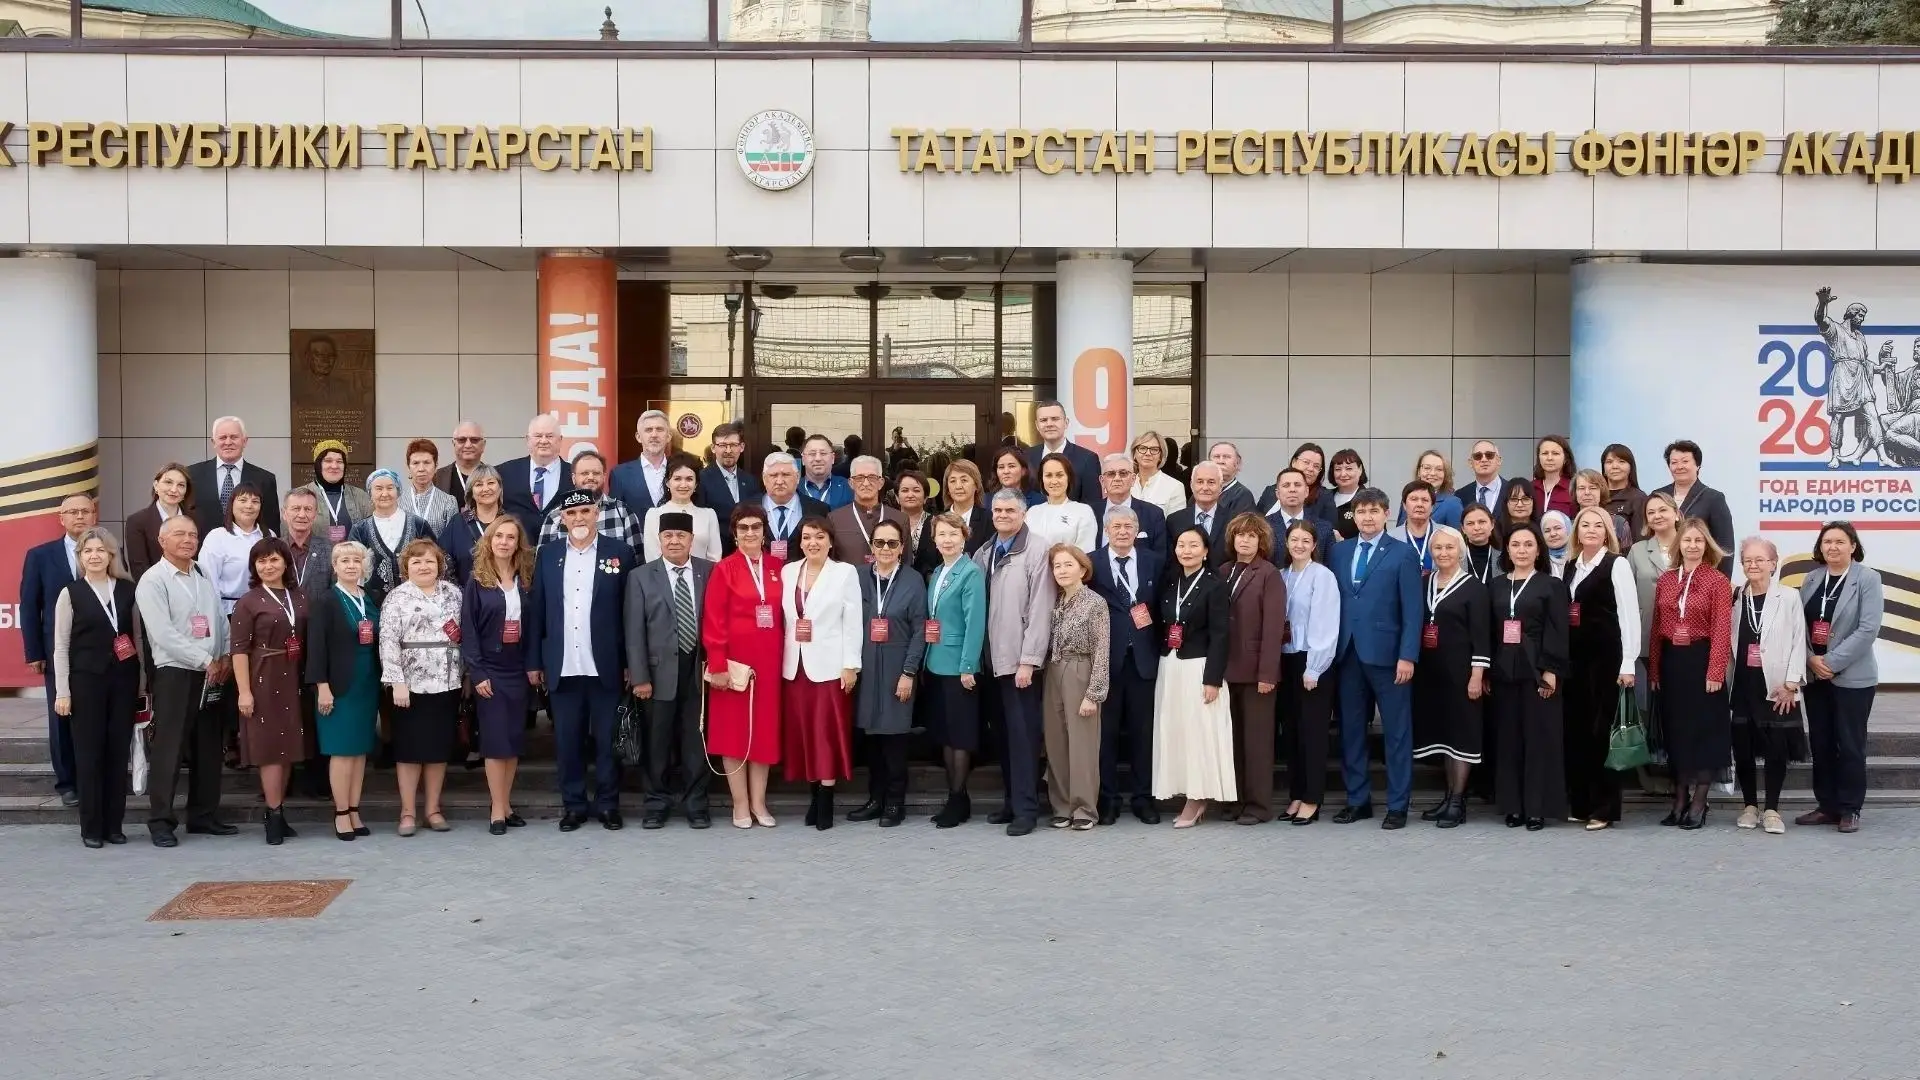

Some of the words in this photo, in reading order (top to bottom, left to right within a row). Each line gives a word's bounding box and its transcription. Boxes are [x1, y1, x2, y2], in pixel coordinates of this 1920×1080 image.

[28, 121, 361, 170] РЕСПУБЛИКИ
[377, 123, 654, 172] ТАТАРСТАН
[890, 128, 1156, 175] ТАТАРСТАН
[1176, 129, 1556, 179] РЕСПУБЛИКАСЫ
[1570, 129, 1767, 177] ФӘННӘР
[1777, 131, 1920, 184] АКАД
[747, 169, 804, 188] ТАТАРСТАН
[1758, 340, 1833, 397] 20
[1758, 399, 1831, 456] 26
[1760, 479, 1799, 496] ГОД
[1806, 479, 1913, 496] ЕДИНСТВА
[1760, 498, 1856, 515] НАРОДОВ
[1862, 498, 1920, 513] РОСС
